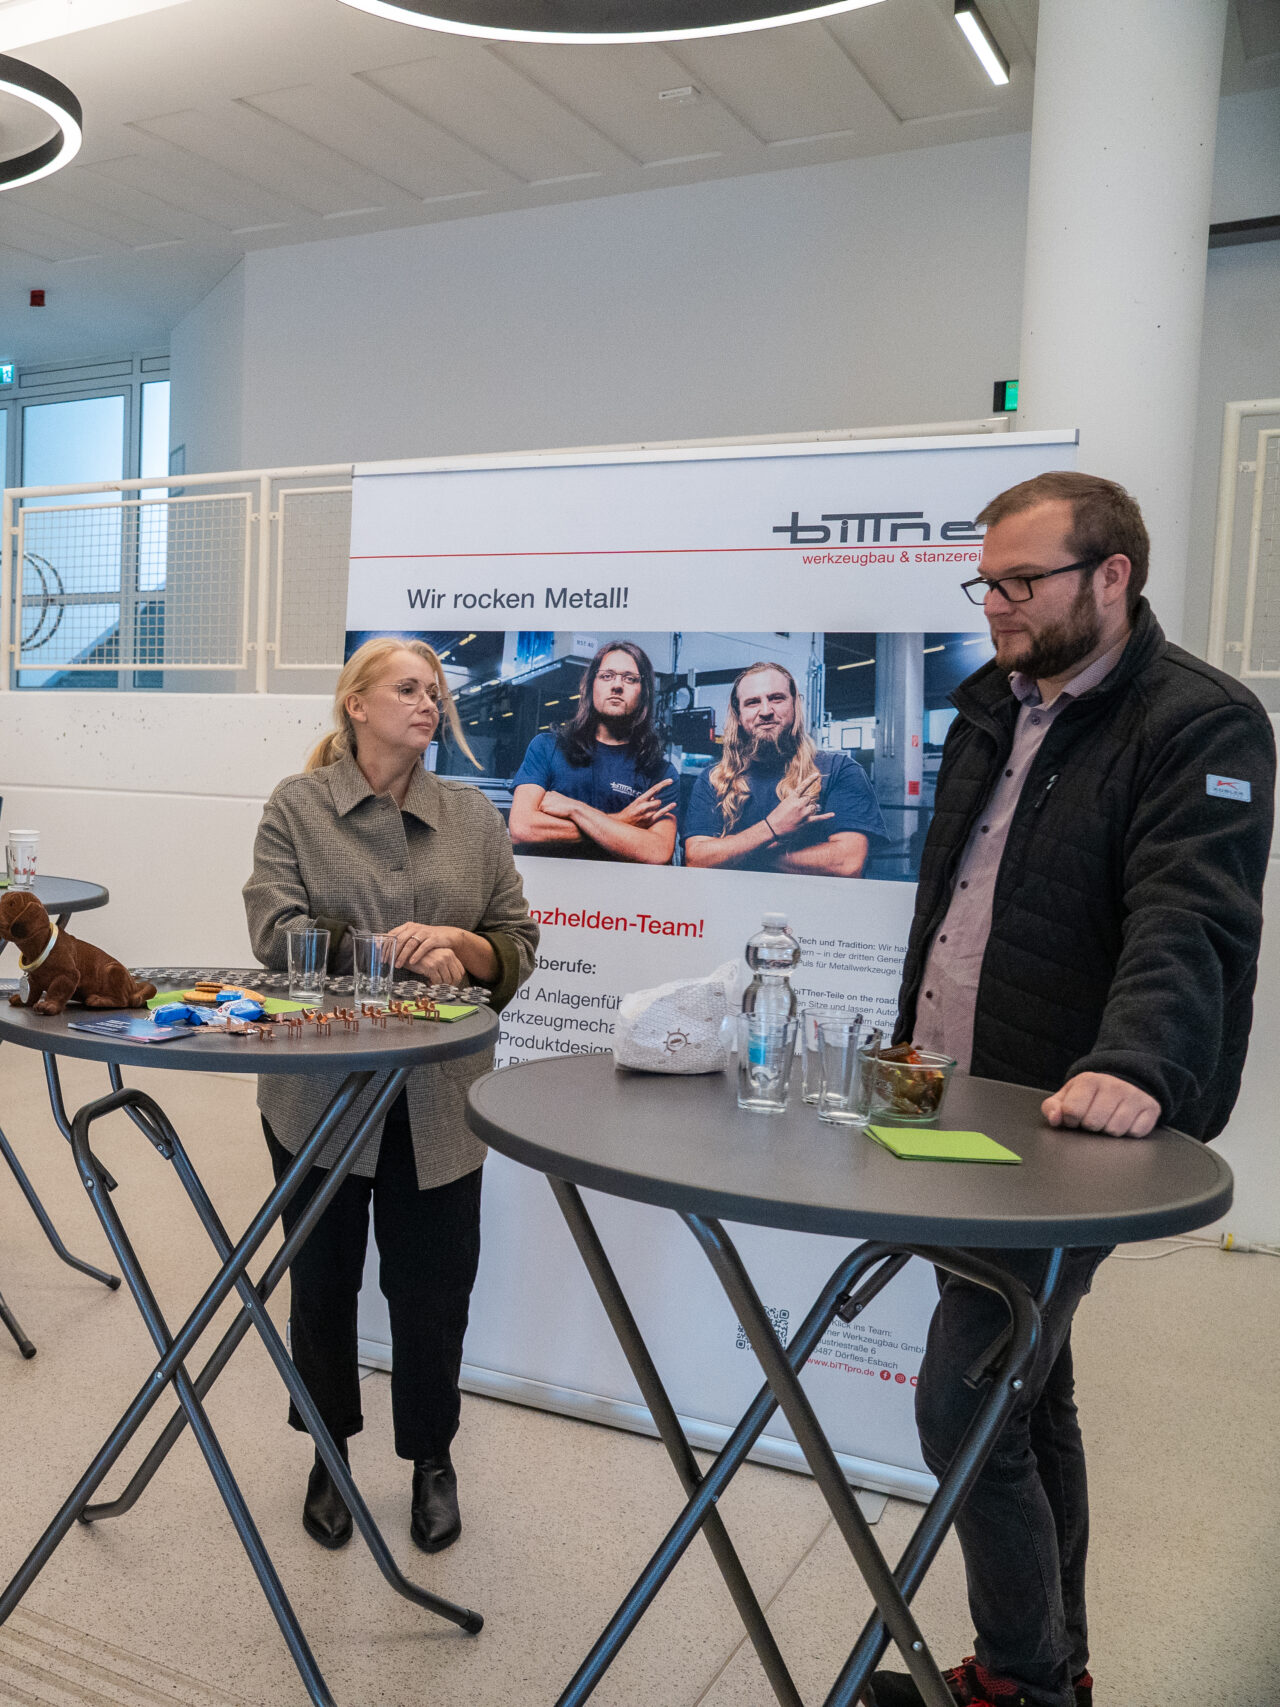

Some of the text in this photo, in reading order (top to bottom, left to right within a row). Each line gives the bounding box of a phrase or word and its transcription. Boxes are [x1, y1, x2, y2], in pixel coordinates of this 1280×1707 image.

[802, 549, 982, 567] werkzeugbau & stanzerei
[407, 586, 629, 609] Wir rocken Metall!
[529, 906, 705, 940] nzhelden-Team!
[798, 936, 908, 953] Tech und Tradition: Wir hab
[823, 950, 831, 958] in
[833, 951, 846, 960] der
[848, 952, 875, 962] dritten
[535, 955, 597, 976] sberufe:
[816, 960, 827, 970] für
[829, 961, 897, 977] Metallwerkzeuge
[831, 1003, 846, 1012] und
[847, 993, 858, 1002] on
[860, 994, 874, 1004] the
[876, 996, 898, 1006] road:
[853, 1324, 866, 1333] ins
[821, 1338, 877, 1355] ustriestraße 6
[826, 1329, 841, 1338] ner
[842, 1331, 899, 1349] Werkzeugbau
